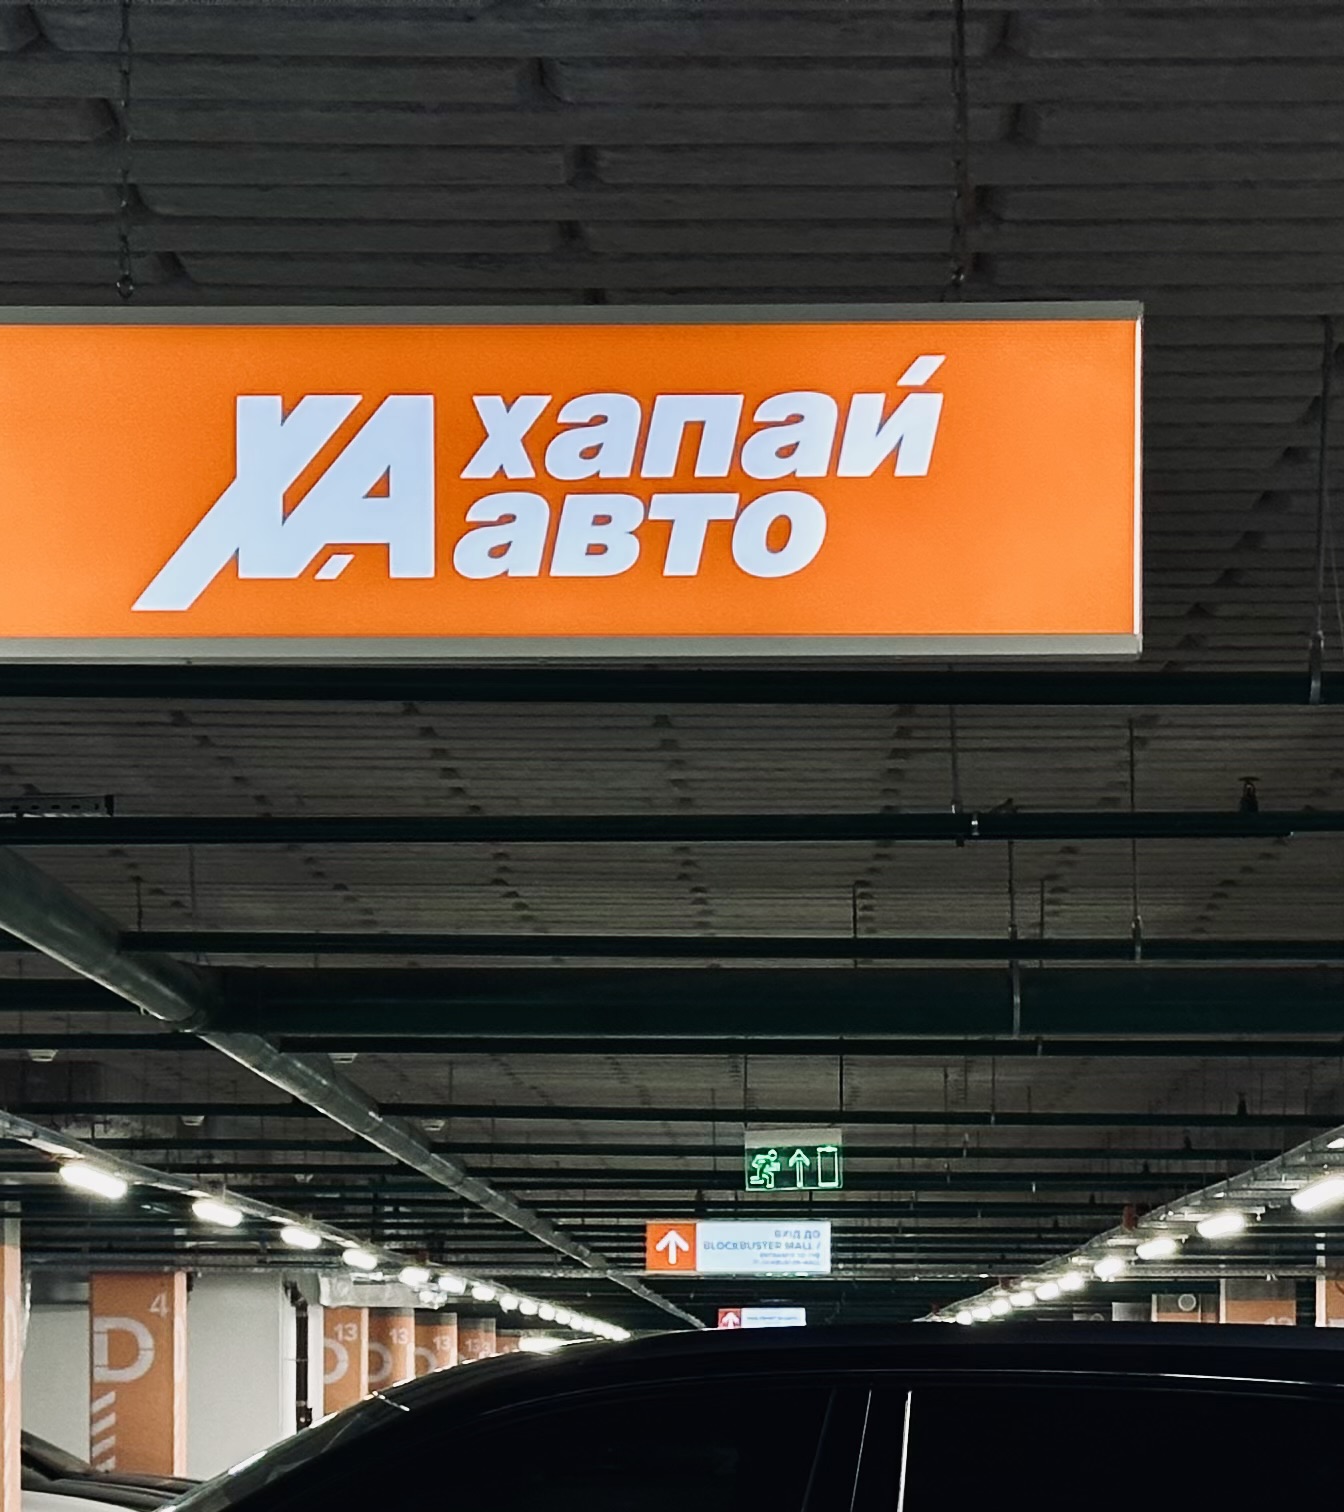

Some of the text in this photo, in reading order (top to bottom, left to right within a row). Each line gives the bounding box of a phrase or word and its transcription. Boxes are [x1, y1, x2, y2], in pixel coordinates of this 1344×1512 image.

[460, 354, 947, 480] хапай
[452, 490, 827, 578] авто
[149, 1291, 169, 1318] 4
[334, 1323, 358, 1341] 13
[389, 1328, 409, 1345] 13
[433, 1336, 451, 1351] 13
[93, 1317, 155, 1383] D
